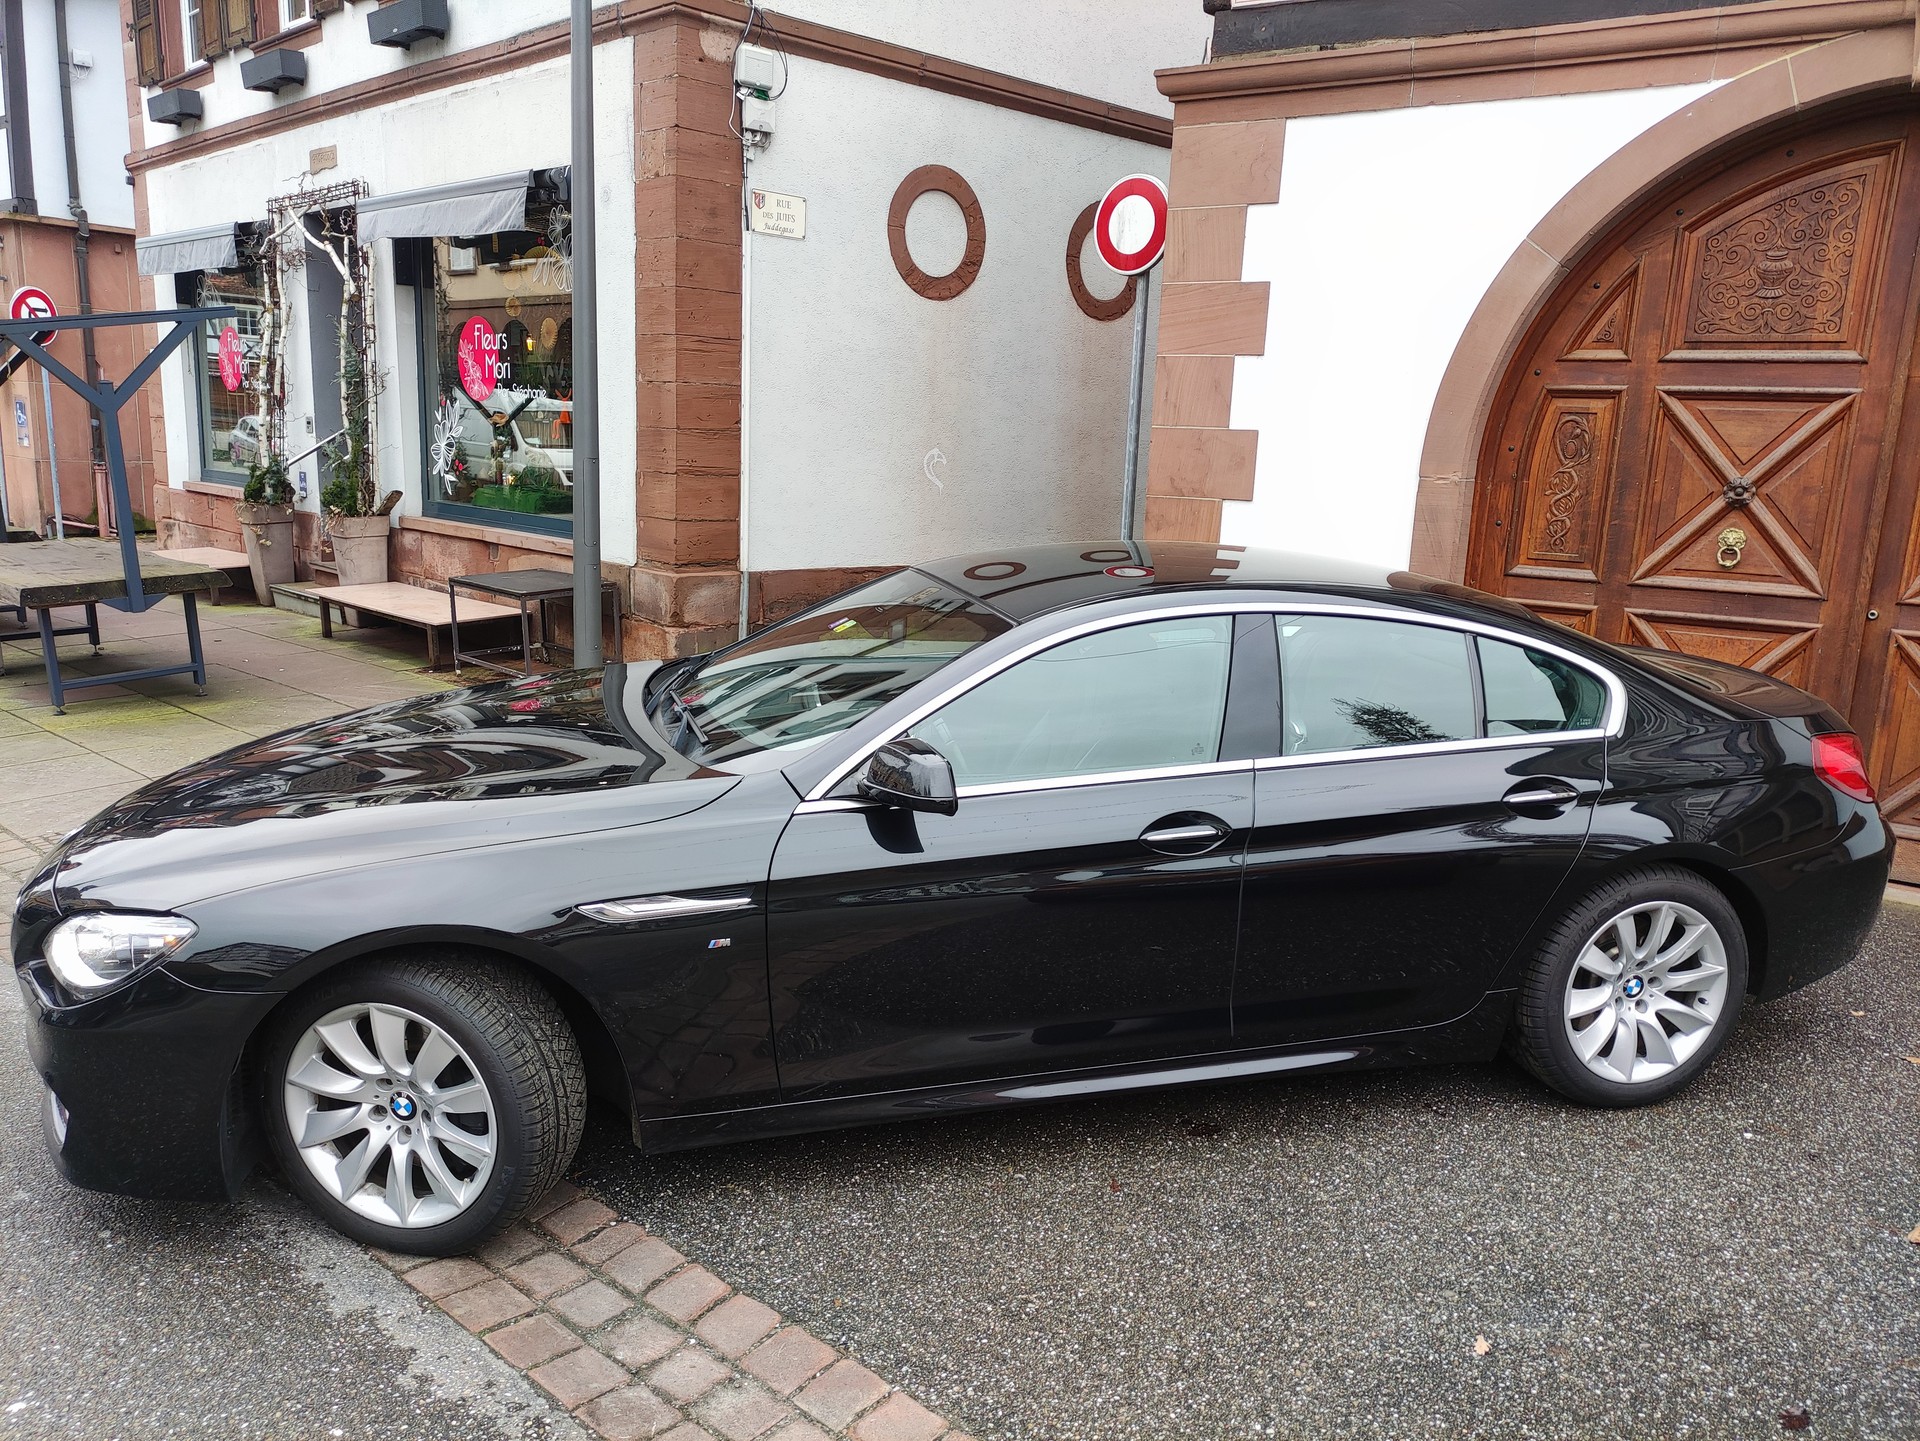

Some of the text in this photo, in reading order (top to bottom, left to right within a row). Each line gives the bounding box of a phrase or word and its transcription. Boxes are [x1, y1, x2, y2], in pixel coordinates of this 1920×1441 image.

[776, 199, 792, 210] RUE
[762, 211, 796, 223] DES JUIFS
[763, 222, 795, 234] Juddegass
[474, 324, 508, 350] Fleurs
[234, 353, 250, 374] Mori
[485, 353, 511, 379] Mori
[497, 383, 547, 403] Par Stéphanie
